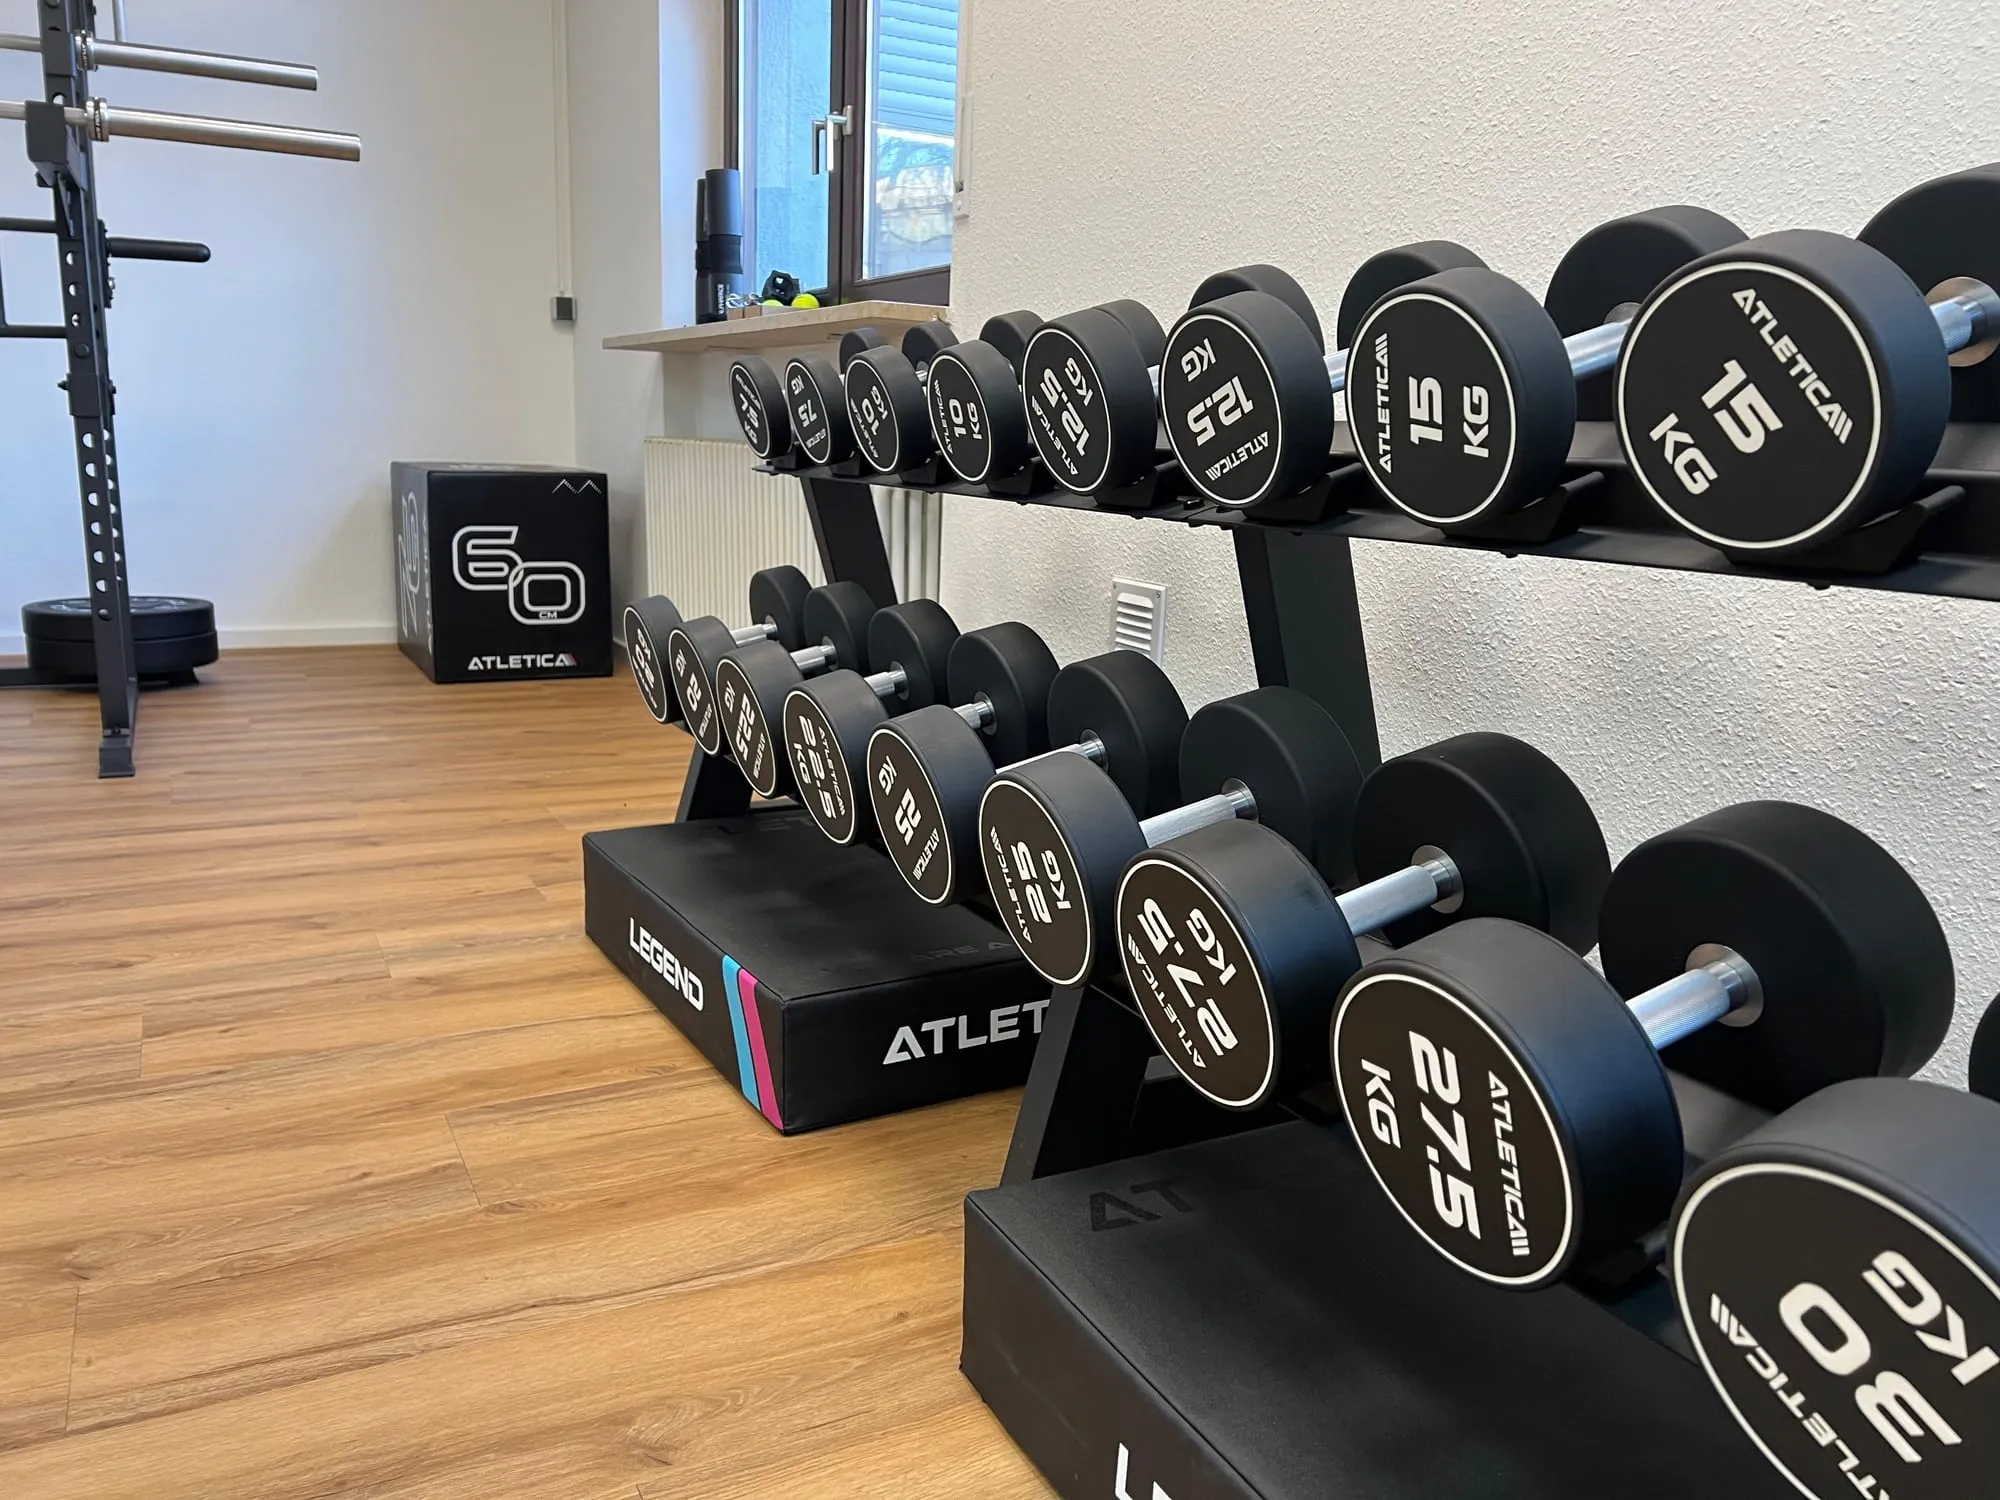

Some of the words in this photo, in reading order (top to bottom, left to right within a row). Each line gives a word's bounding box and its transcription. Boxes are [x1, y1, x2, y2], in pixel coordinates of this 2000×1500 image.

[791, 375, 805, 395] KG
[1064, 357, 1093, 406] KG
[1180, 337, 1216, 382] KG
[1732, 288, 1853, 444] ATLETICA
[862, 398, 879, 435] 10
[871, 385, 888, 420] KG
[934, 379, 953, 454] ATLETICA
[949, 399, 967, 438] 10
[967, 402, 982, 439] KG
[1031, 395, 1079, 475] ATLETICA
[1040, 368, 1090, 457] 12.5
[1186, 375, 1254, 446] 12.5
[1378, 333, 1391, 473] ATLETICA
[1408, 376, 1443, 445] 15
[1463, 386, 1489, 458] KG
[1701, 359, 1784, 454] 15
[1205, 431, 1270, 481] ATLETICA
[1649, 413, 1719, 495] KG
[452, 525, 586, 625] 60
[467, 653, 577, 671] ATLETICA
[686, 672, 702, 712] 20
[724, 680, 736, 714] KG
[735, 692, 756, 761] 22.5
[793, 742, 813, 785] KG
[799, 715, 836, 820] 22.5
[818, 726, 846, 816] ATLETICA
[878, 755, 897, 796] KG
[894, 788, 922, 846] 25
[912, 828, 940, 880] ATLETICA
[991, 826, 1033, 943] ATLETICA
[1010, 841, 1052, 924] 25
[1041, 849, 1072, 910] KG
[629, 917, 704, 1011] LEGEND
[1137, 898, 1239, 1056] 27.5
[1186, 907, 1238, 986] KG
[1128, 934, 1207, 1069] ATLETICA
[1361, 1059, 1401, 1149] KG
[1409, 1031, 1481, 1240] 27.5
[1488, 1070, 1531, 1256] ATLETICA
[1861, 1250, 2000, 1386] KG
[1710, 1293, 1890, 1500] TLETICA
[1779, 1282, 1962, 1463] 30
